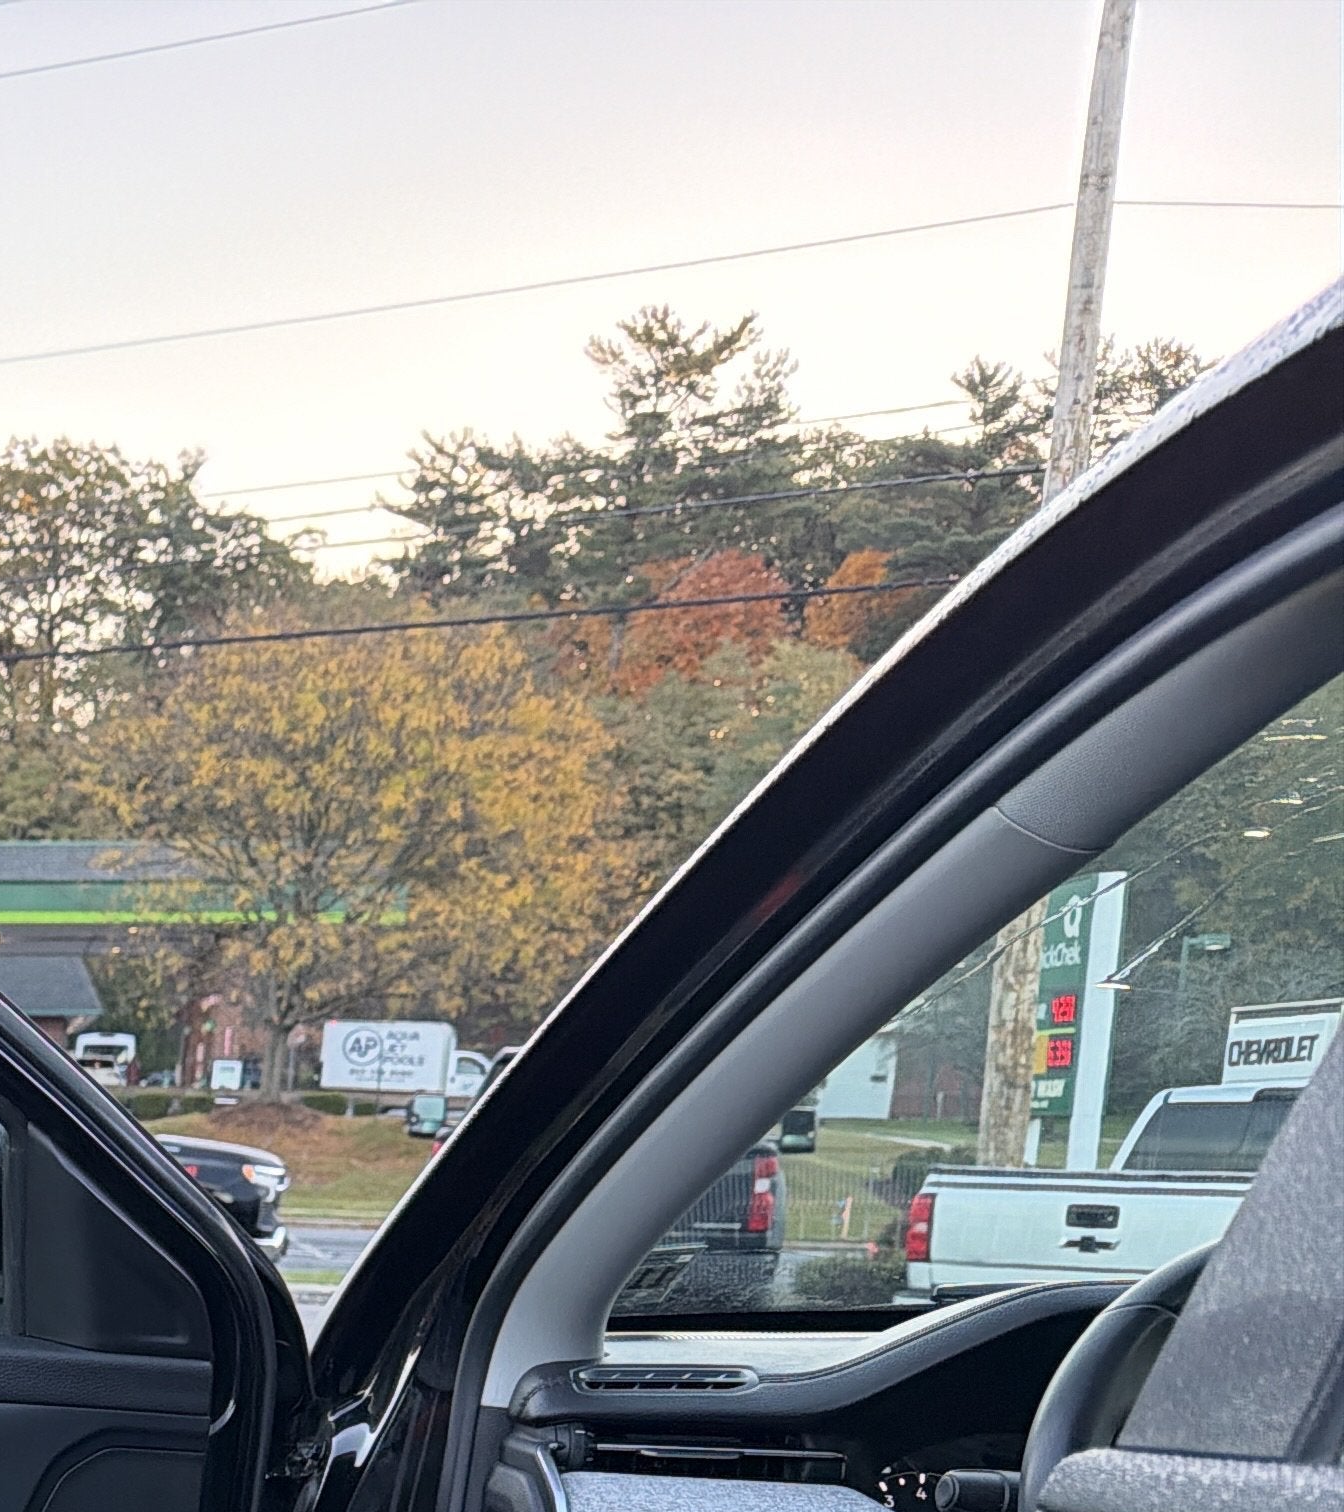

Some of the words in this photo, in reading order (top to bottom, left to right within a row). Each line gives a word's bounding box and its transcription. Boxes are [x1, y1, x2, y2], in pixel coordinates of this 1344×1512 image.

[1040, 939, 1082, 969] ickChek
[1228, 1033, 1320, 1067] CHEVROLET
[883, 1494, 895, 1508] 3
[915, 1487, 928, 1501] 4
